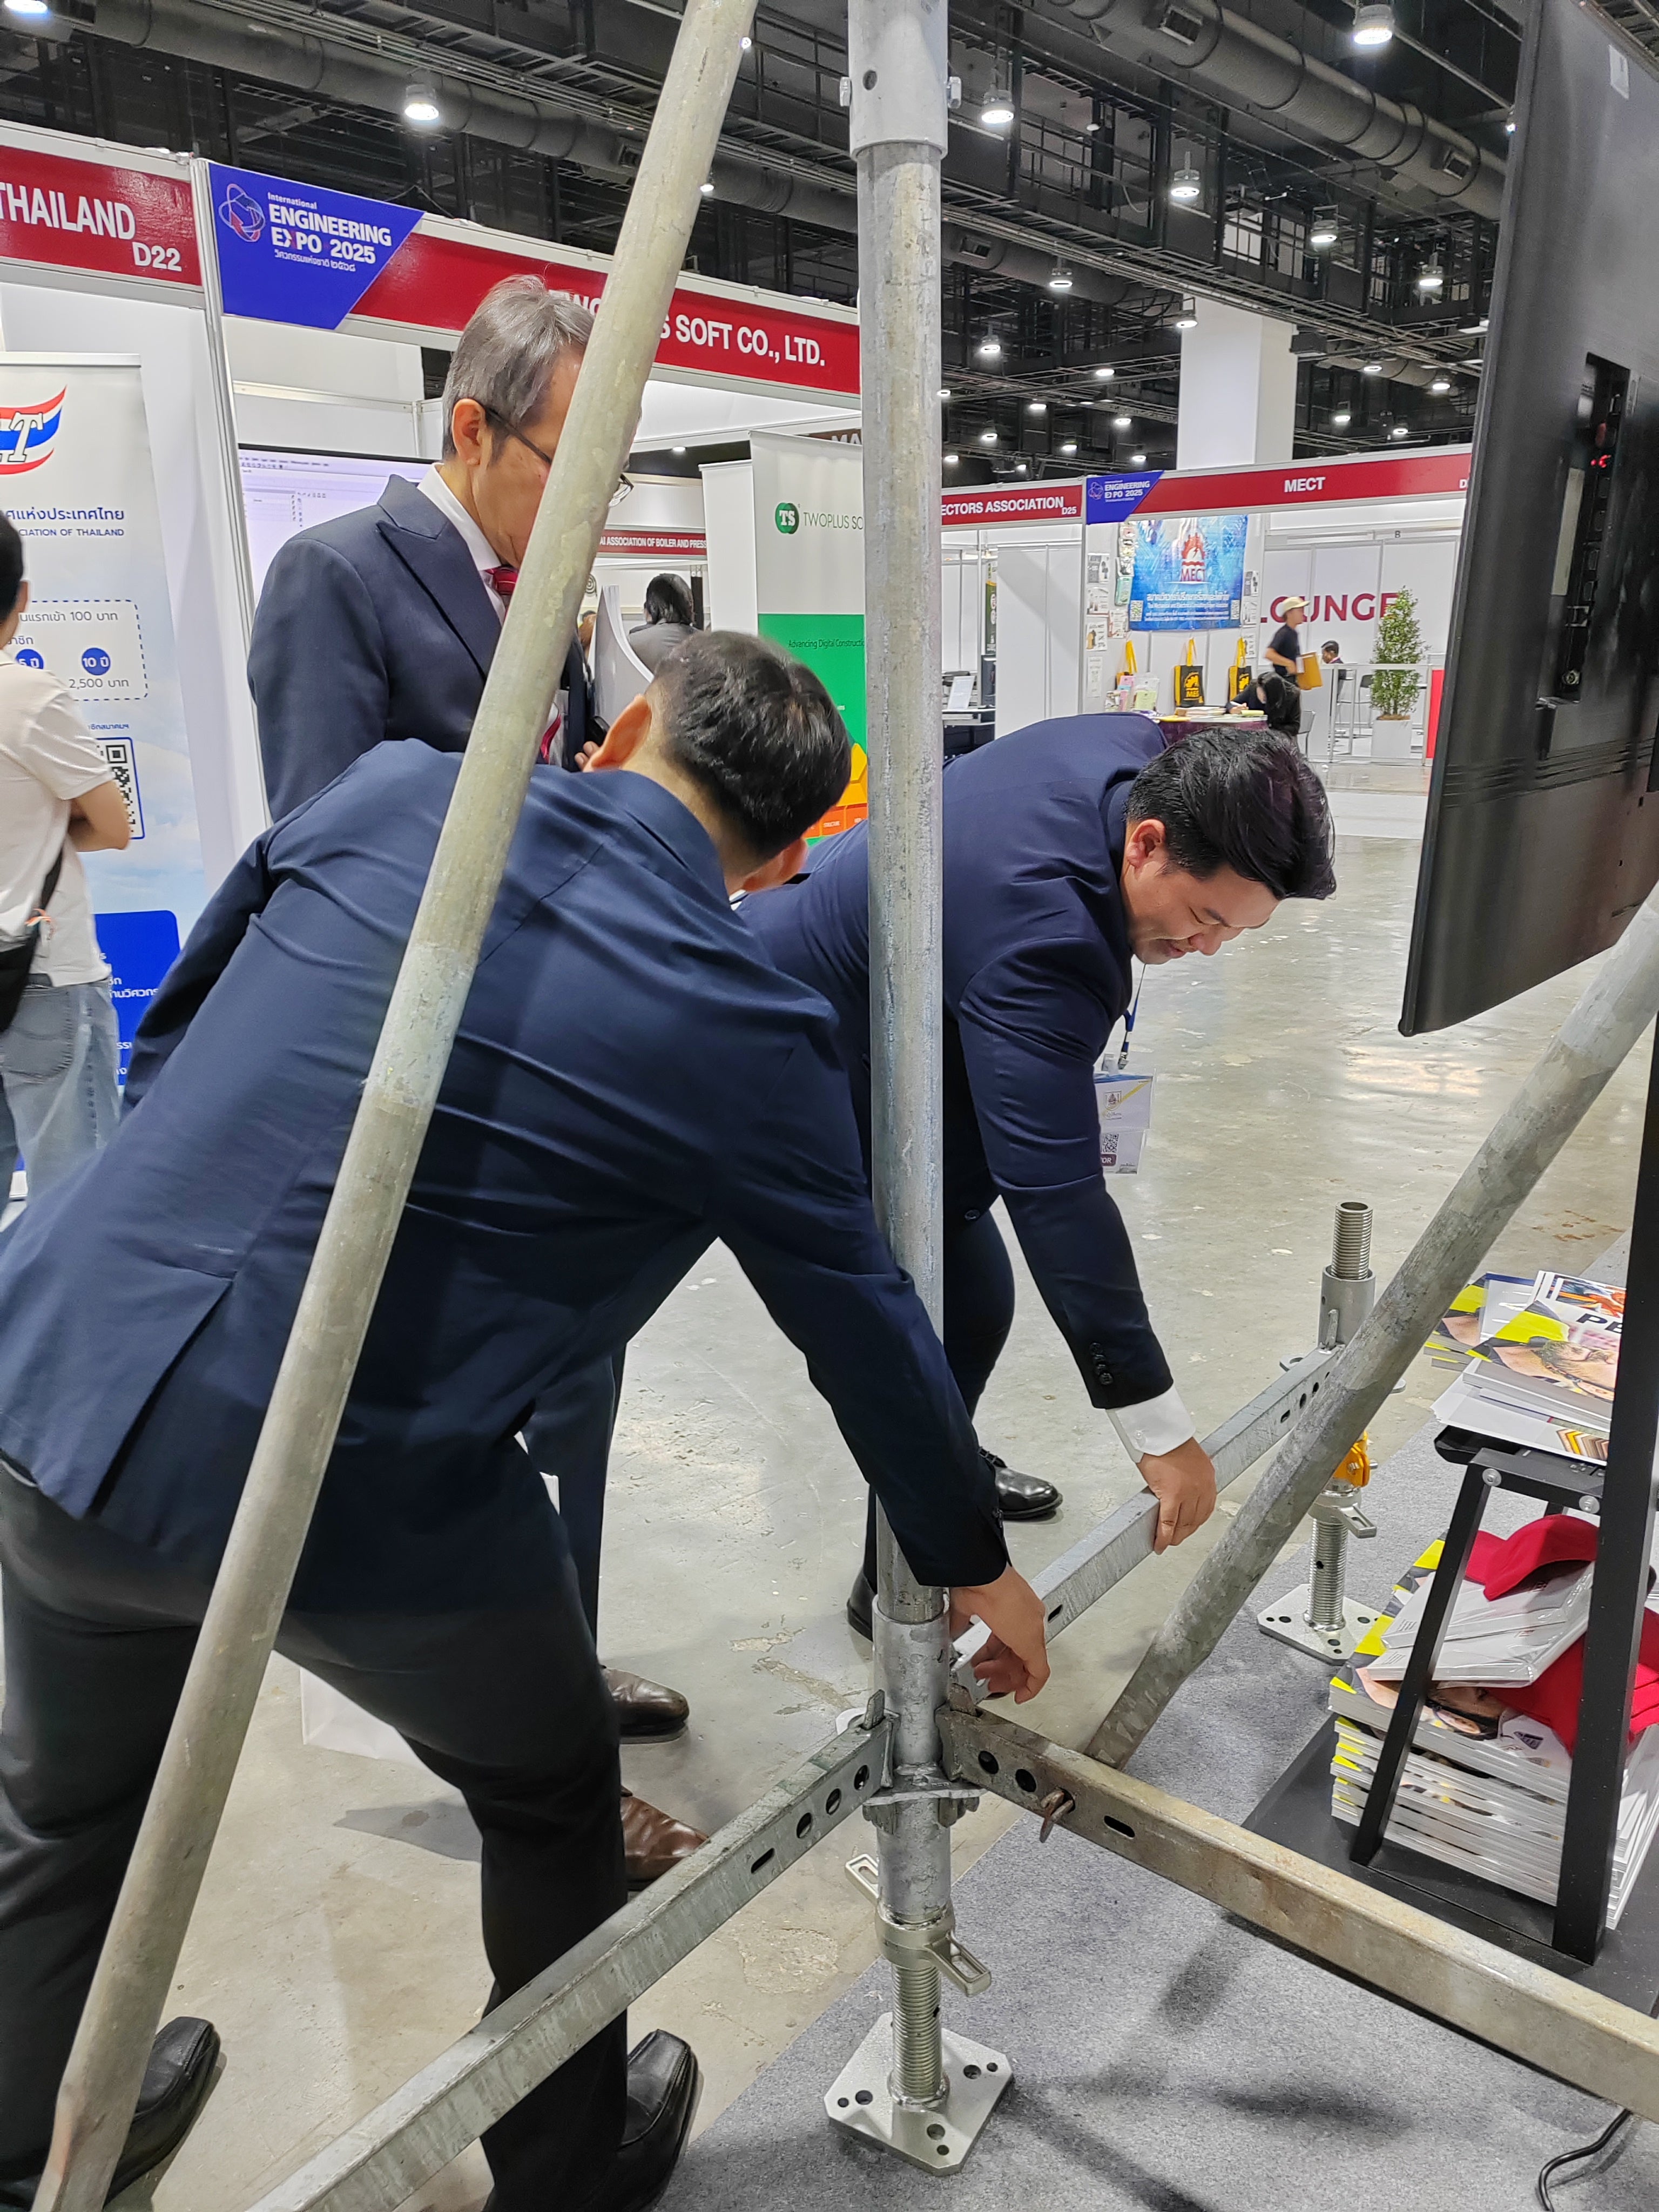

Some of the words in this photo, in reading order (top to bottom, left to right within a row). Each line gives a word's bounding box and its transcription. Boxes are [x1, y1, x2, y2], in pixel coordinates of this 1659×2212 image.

[268, 192, 318, 210] International
[268, 203, 392, 246] ENGINEERING
[271, 226, 322, 254] EXPO
[329, 239, 376, 264] 2025
[132, 241, 181, 272] D22
[676, 314, 732, 349] SOFT
[737, 326, 780, 363] CO.,
[785, 335, 825, 366] LTD.
[1104, 481, 1150, 491] ENGINEERING
[1125, 489, 1143, 497] 2025
[1284, 477, 1326, 493] MECT
[985, 496, 1064, 513] ASSOCIATION
[1062, 507, 1077, 515] D25
[779, 510, 795, 526] TS
[804, 512, 849, 529] TWOPLUS
[606, 536, 646, 547] ASSOCIATION
[648, 538, 656, 547] OF
[656, 538, 676, 547] BOILER
[677, 539, 689, 548] AND
[71, 612, 92, 621] 100
[97, 612, 118, 621] บาท
[788, 639, 817, 649] Advancing
[819, 639, 835, 649] Digital
[83, 658, 97, 667] 10
[69, 679, 103, 690] 2,500
[108, 679, 129, 687] บาท
